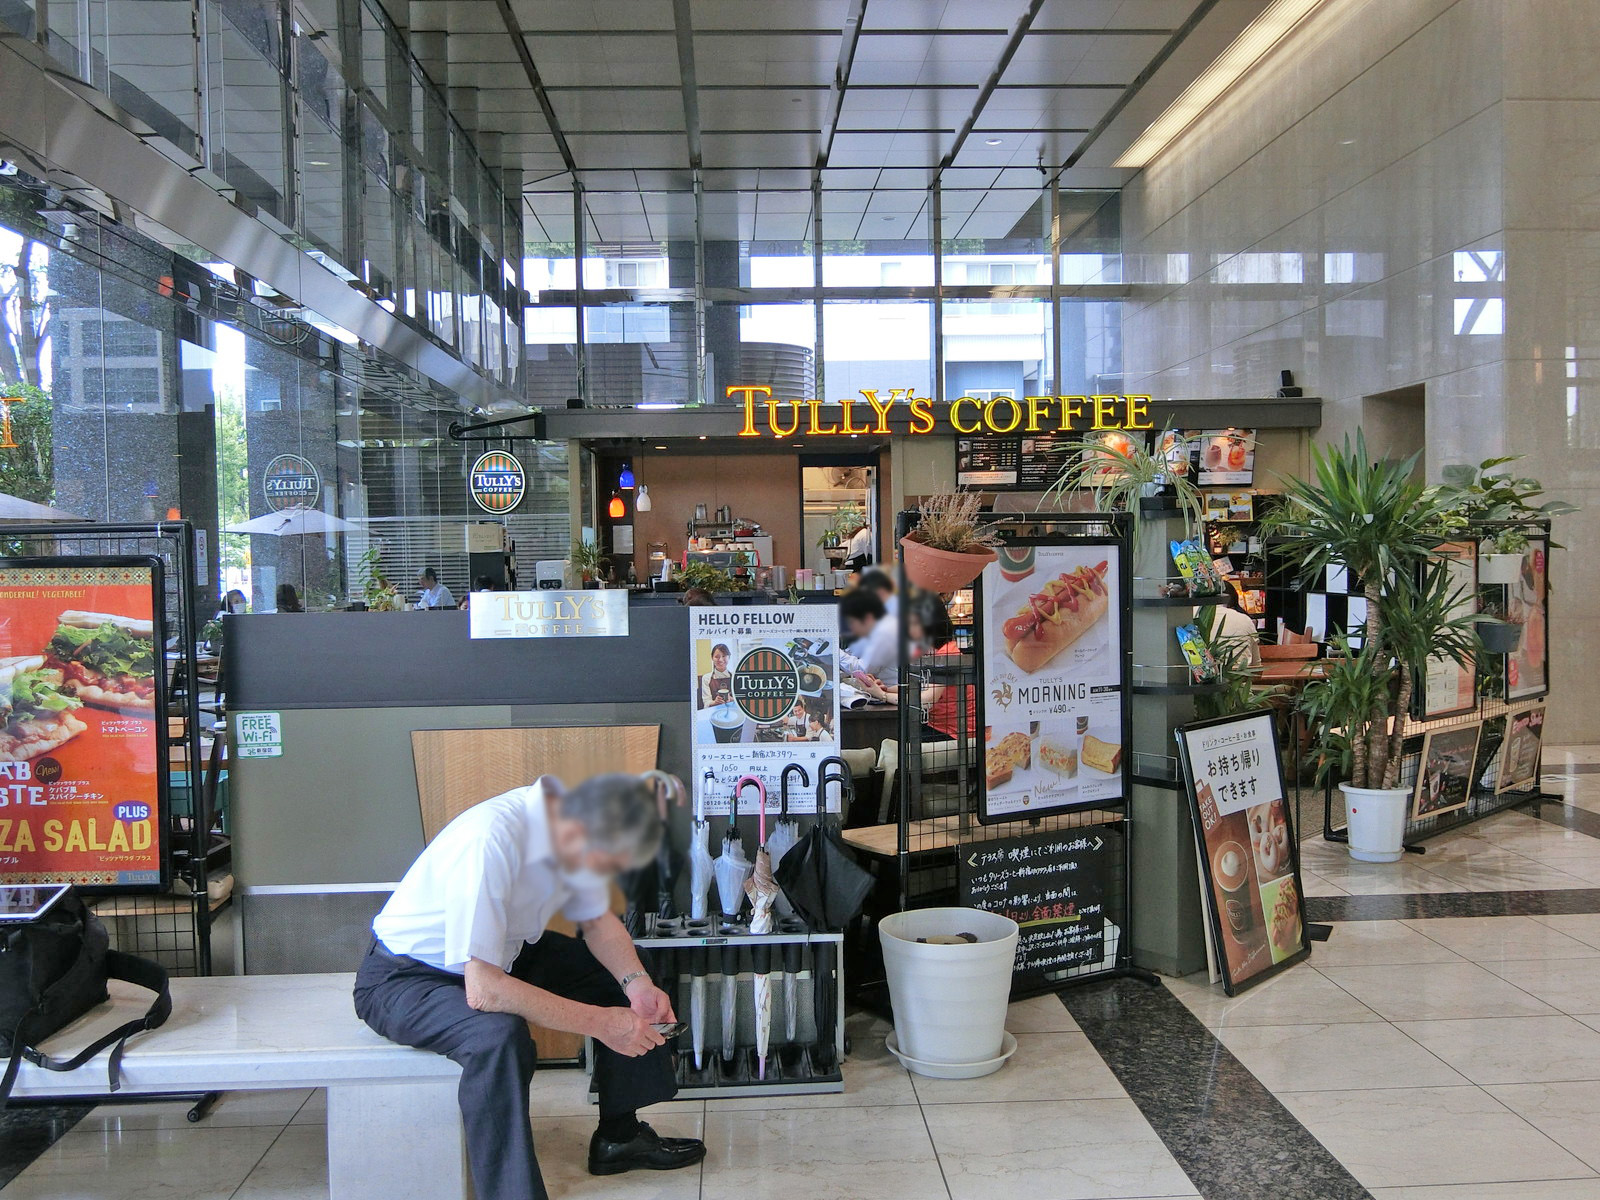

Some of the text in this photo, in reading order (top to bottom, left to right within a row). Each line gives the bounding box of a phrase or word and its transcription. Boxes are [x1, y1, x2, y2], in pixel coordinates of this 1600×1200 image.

[726, 385, 1153, 436] TULLY'S COFFEE
[475, 474, 521, 487] TULLY'S
[42, 589, 86, 599] VEGETABLE!
[495, 594, 605, 621] TULLY'S
[698, 612, 795, 625] HELLO FELLOW
[516, 624, 583, 635] OFFEE
[698, 627, 752, 635] アルバイト募集
[737, 675, 795, 691] TULLY'S
[1039, 676, 1063, 684] TULLY'S
[1018, 682, 1086, 705] MORNING
[242, 719, 271, 730] FREE
[243, 731, 272, 742] Wi-Fi
[720, 763, 739, 772] 1050
[1207, 748, 1260, 777] お持ち帰り
[49, 786, 77, 794] ケバブ風
[1218, 776, 1257, 802] できます
[1199, 795, 1213, 812] TAKE
[118, 805, 148, 819] PLUS
[1202, 804, 1214, 819] OUT
[1204, 812, 1217, 830] OK!
[43, 817, 152, 852] SALAD
[127, 872, 157, 881] TULLY'S
